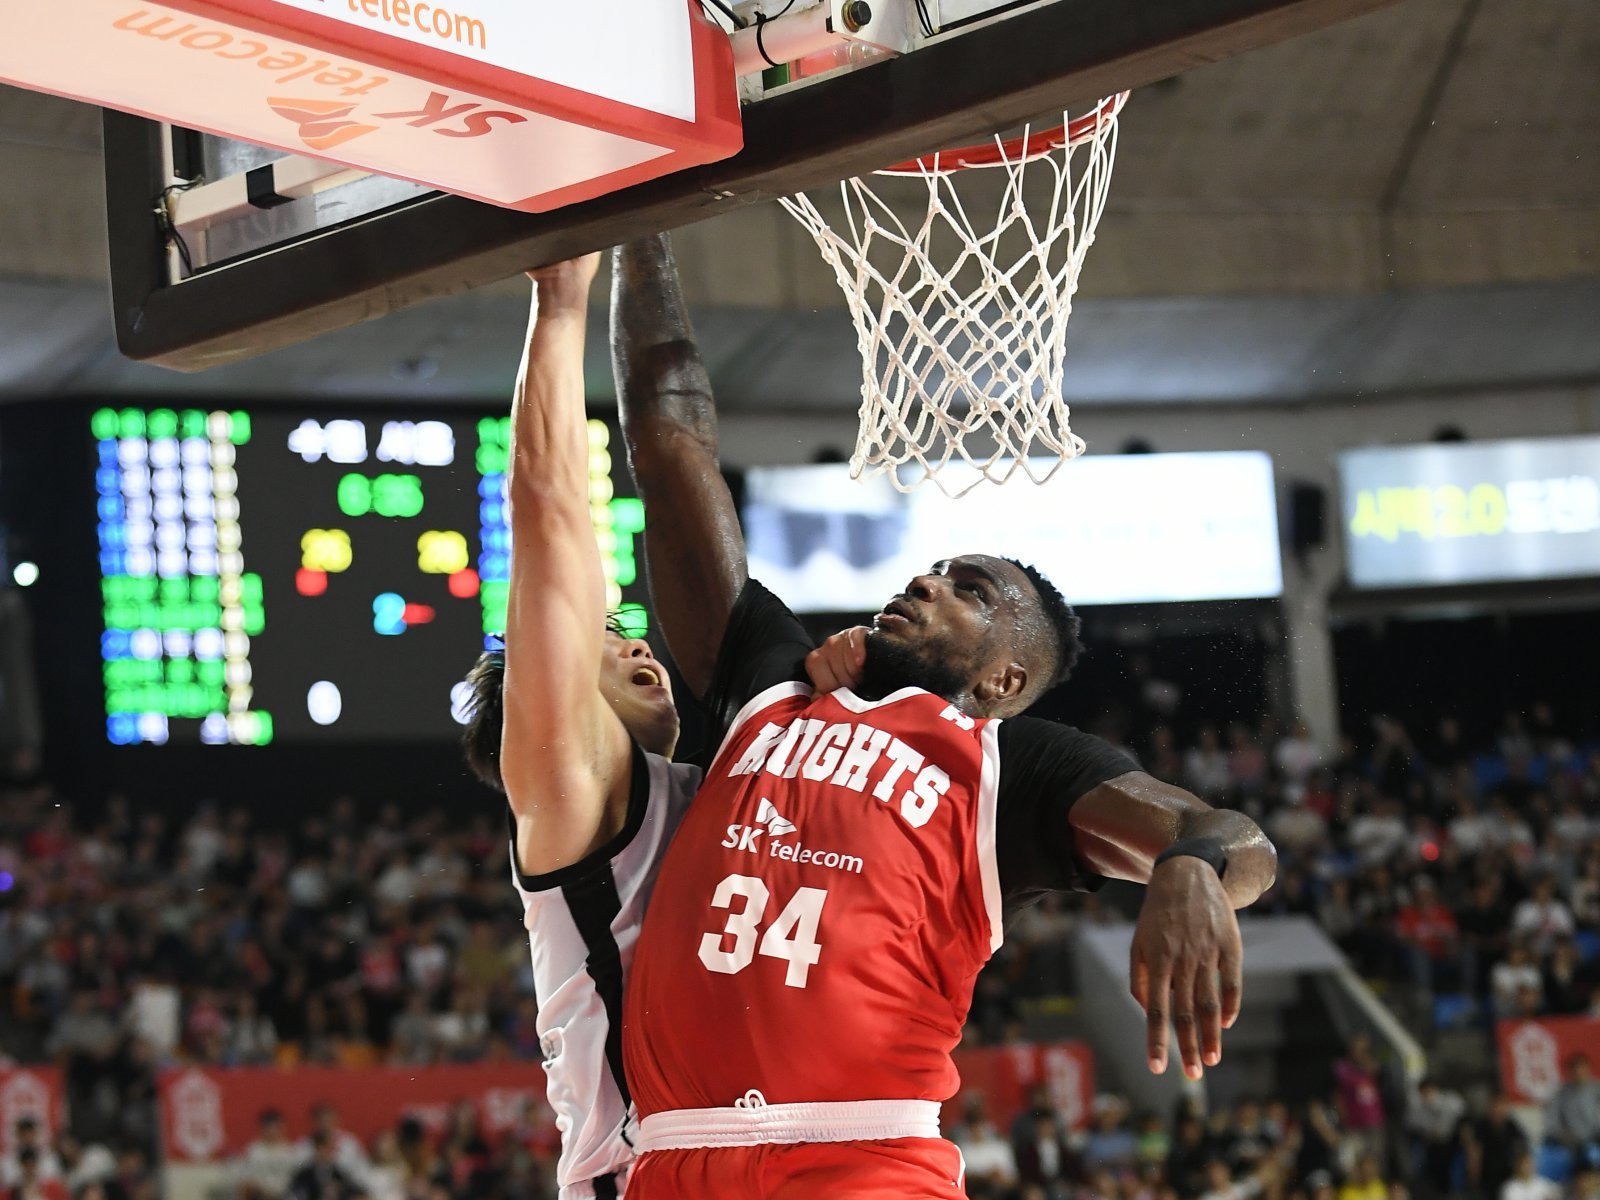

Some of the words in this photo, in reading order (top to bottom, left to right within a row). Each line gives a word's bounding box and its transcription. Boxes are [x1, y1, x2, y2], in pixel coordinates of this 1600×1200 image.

[112, 9, 390, 96] telecom
[348, 0, 487, 50] eecom
[371, 91, 529, 138] SK
[728, 717, 951, 829] KNIGHTS
[721, 824, 764, 854] SK
[770, 839, 864, 874] telecom
[697, 873, 828, 989] 34
